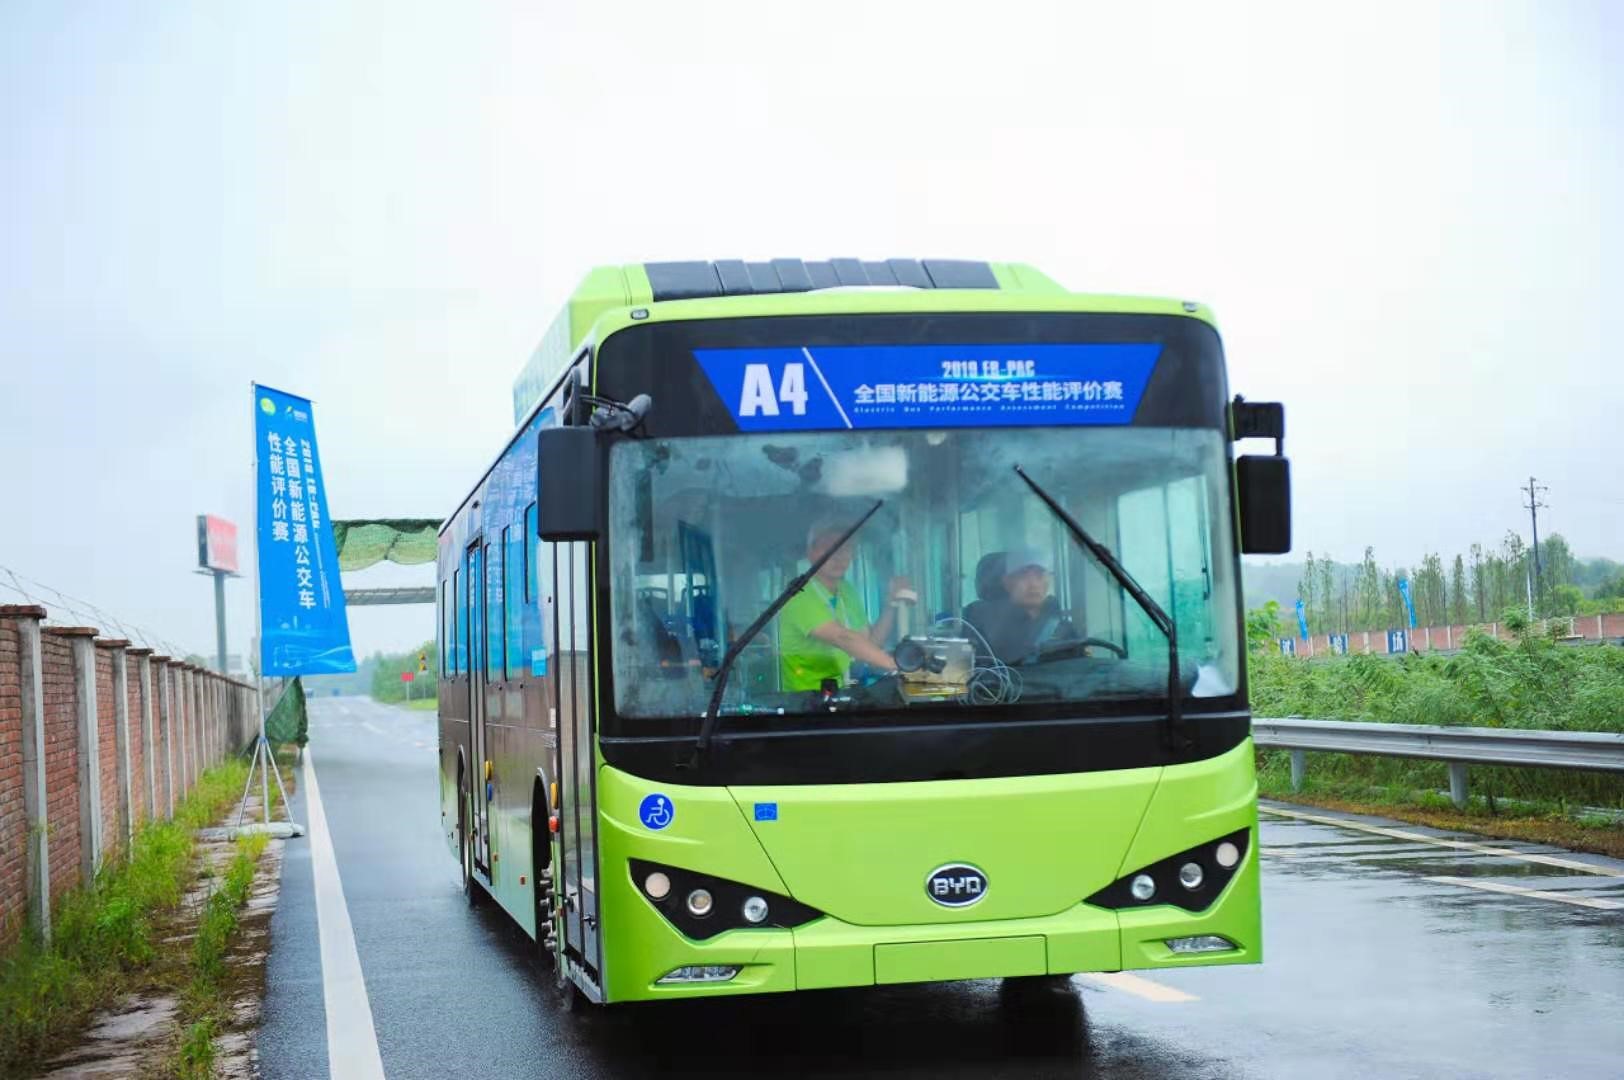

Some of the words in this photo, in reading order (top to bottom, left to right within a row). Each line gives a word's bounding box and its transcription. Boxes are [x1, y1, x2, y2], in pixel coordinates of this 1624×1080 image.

[942, 360, 978, 378] 2019
[739, 363, 808, 416] A4
[853, 381, 1123, 403] 全国新能源公交车性能评价赛
[268, 431, 289, 542] 性能评价赛
[284, 435, 316, 610] 全国新能源公交车
[933, 876, 981, 895] BYD
